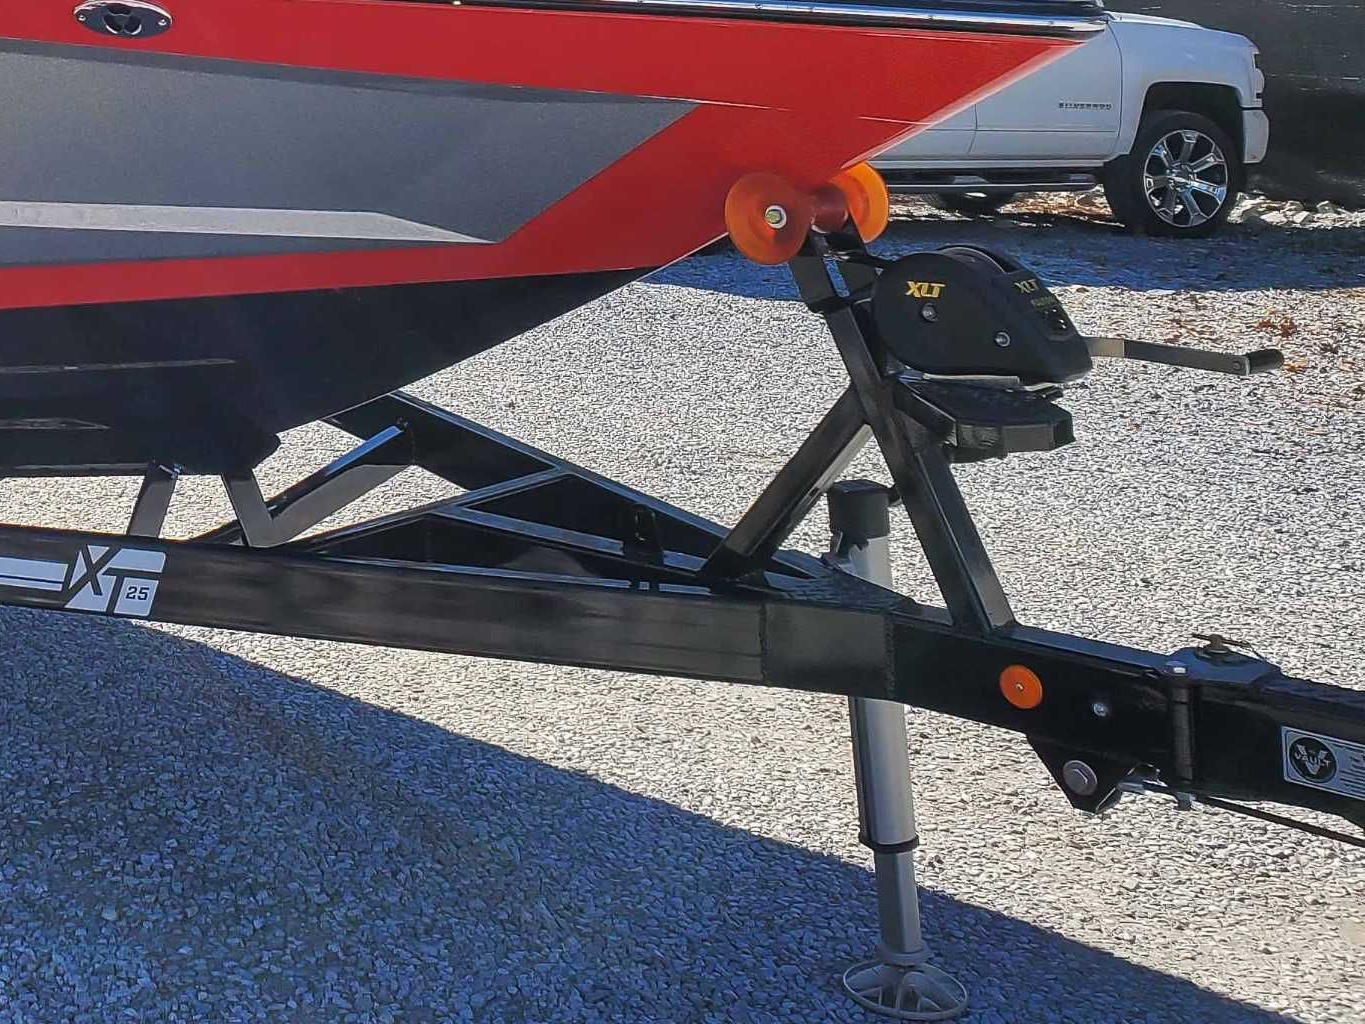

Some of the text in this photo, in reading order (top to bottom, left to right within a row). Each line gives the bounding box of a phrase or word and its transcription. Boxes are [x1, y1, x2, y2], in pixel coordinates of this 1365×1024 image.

[1058, 102, 1112, 111] SILVERADO
[905, 280, 946, 298] XLT
[125, 584, 150, 601] 25
